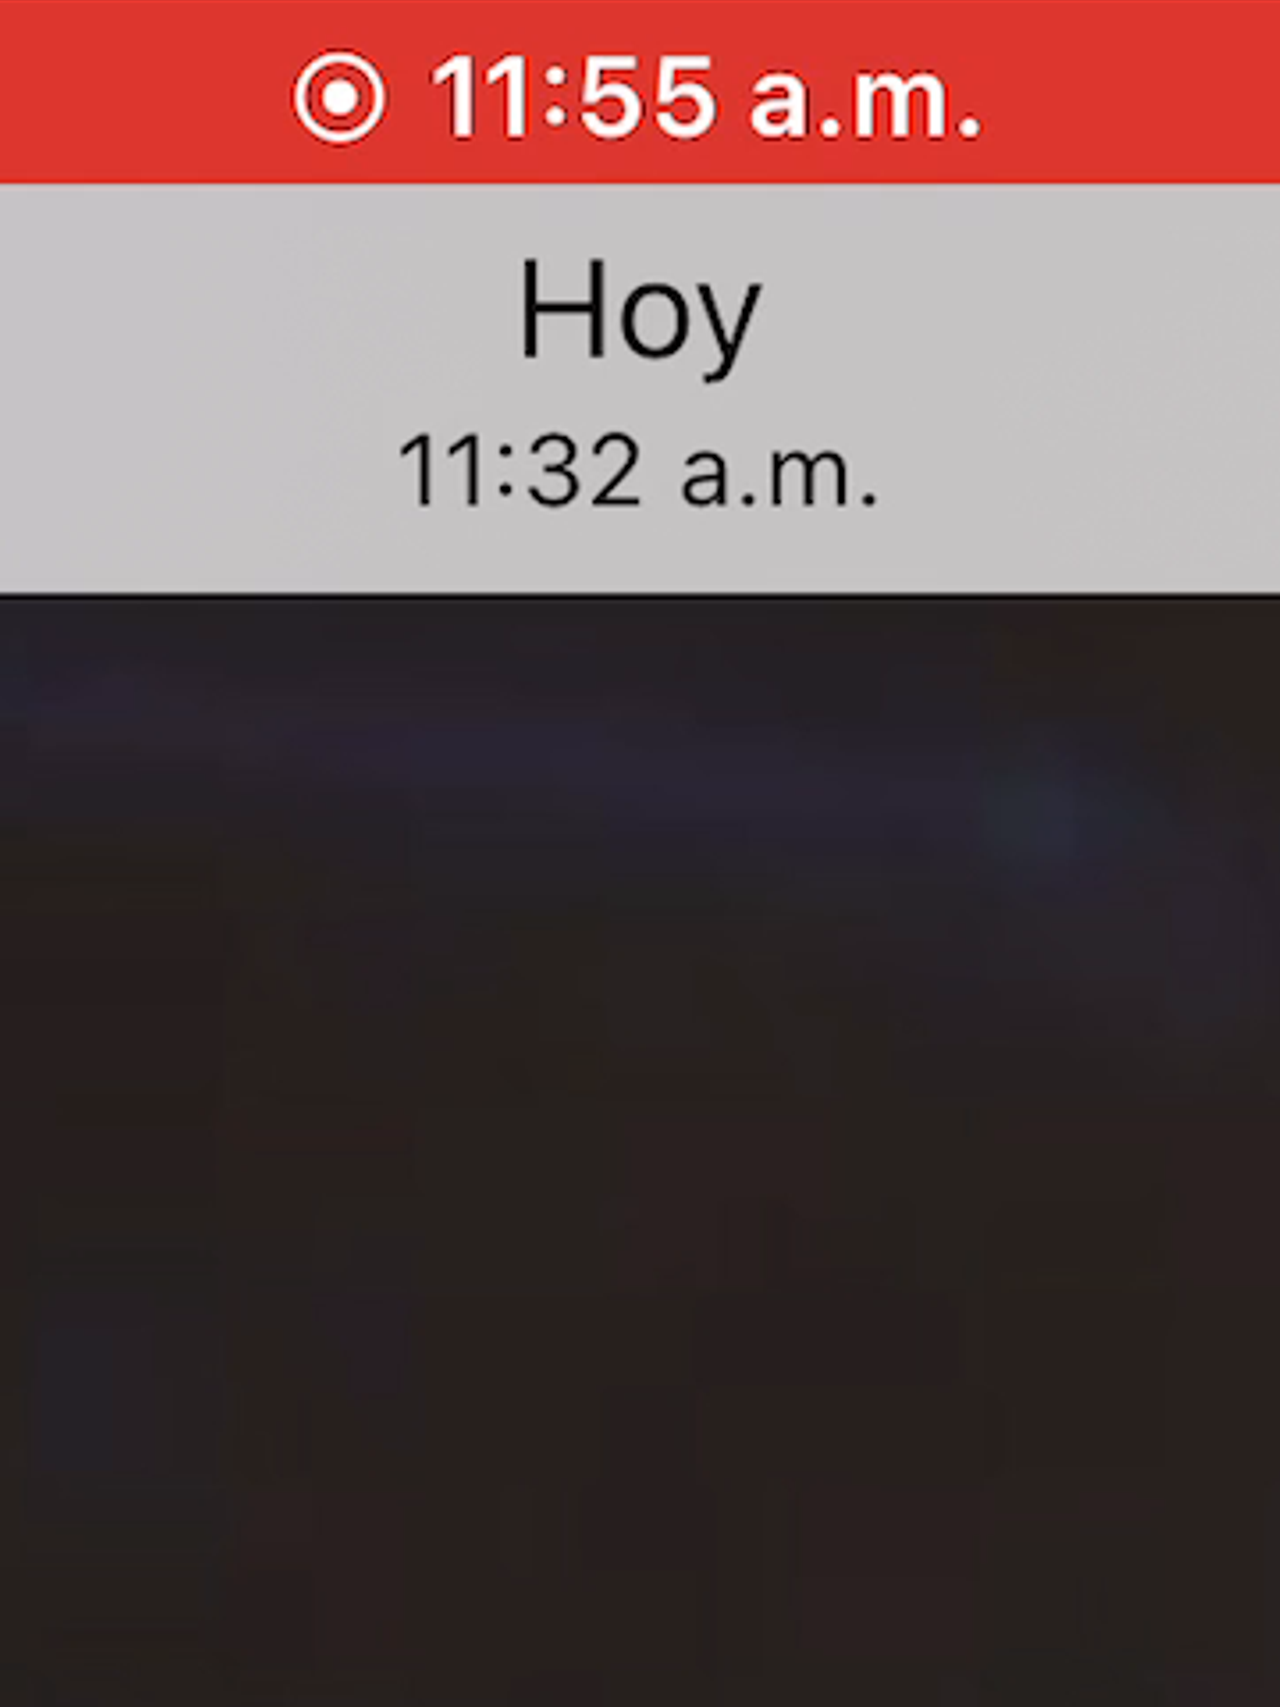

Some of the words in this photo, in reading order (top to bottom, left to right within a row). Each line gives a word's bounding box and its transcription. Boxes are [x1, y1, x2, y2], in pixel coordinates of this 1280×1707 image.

[433, 54, 718, 139] 11:55
[750, 72, 981, 138] a.m.
[523, 257, 763, 385] Hoy
[399, 430, 641, 508] 11:32
[681, 450, 876, 508] a.m.
